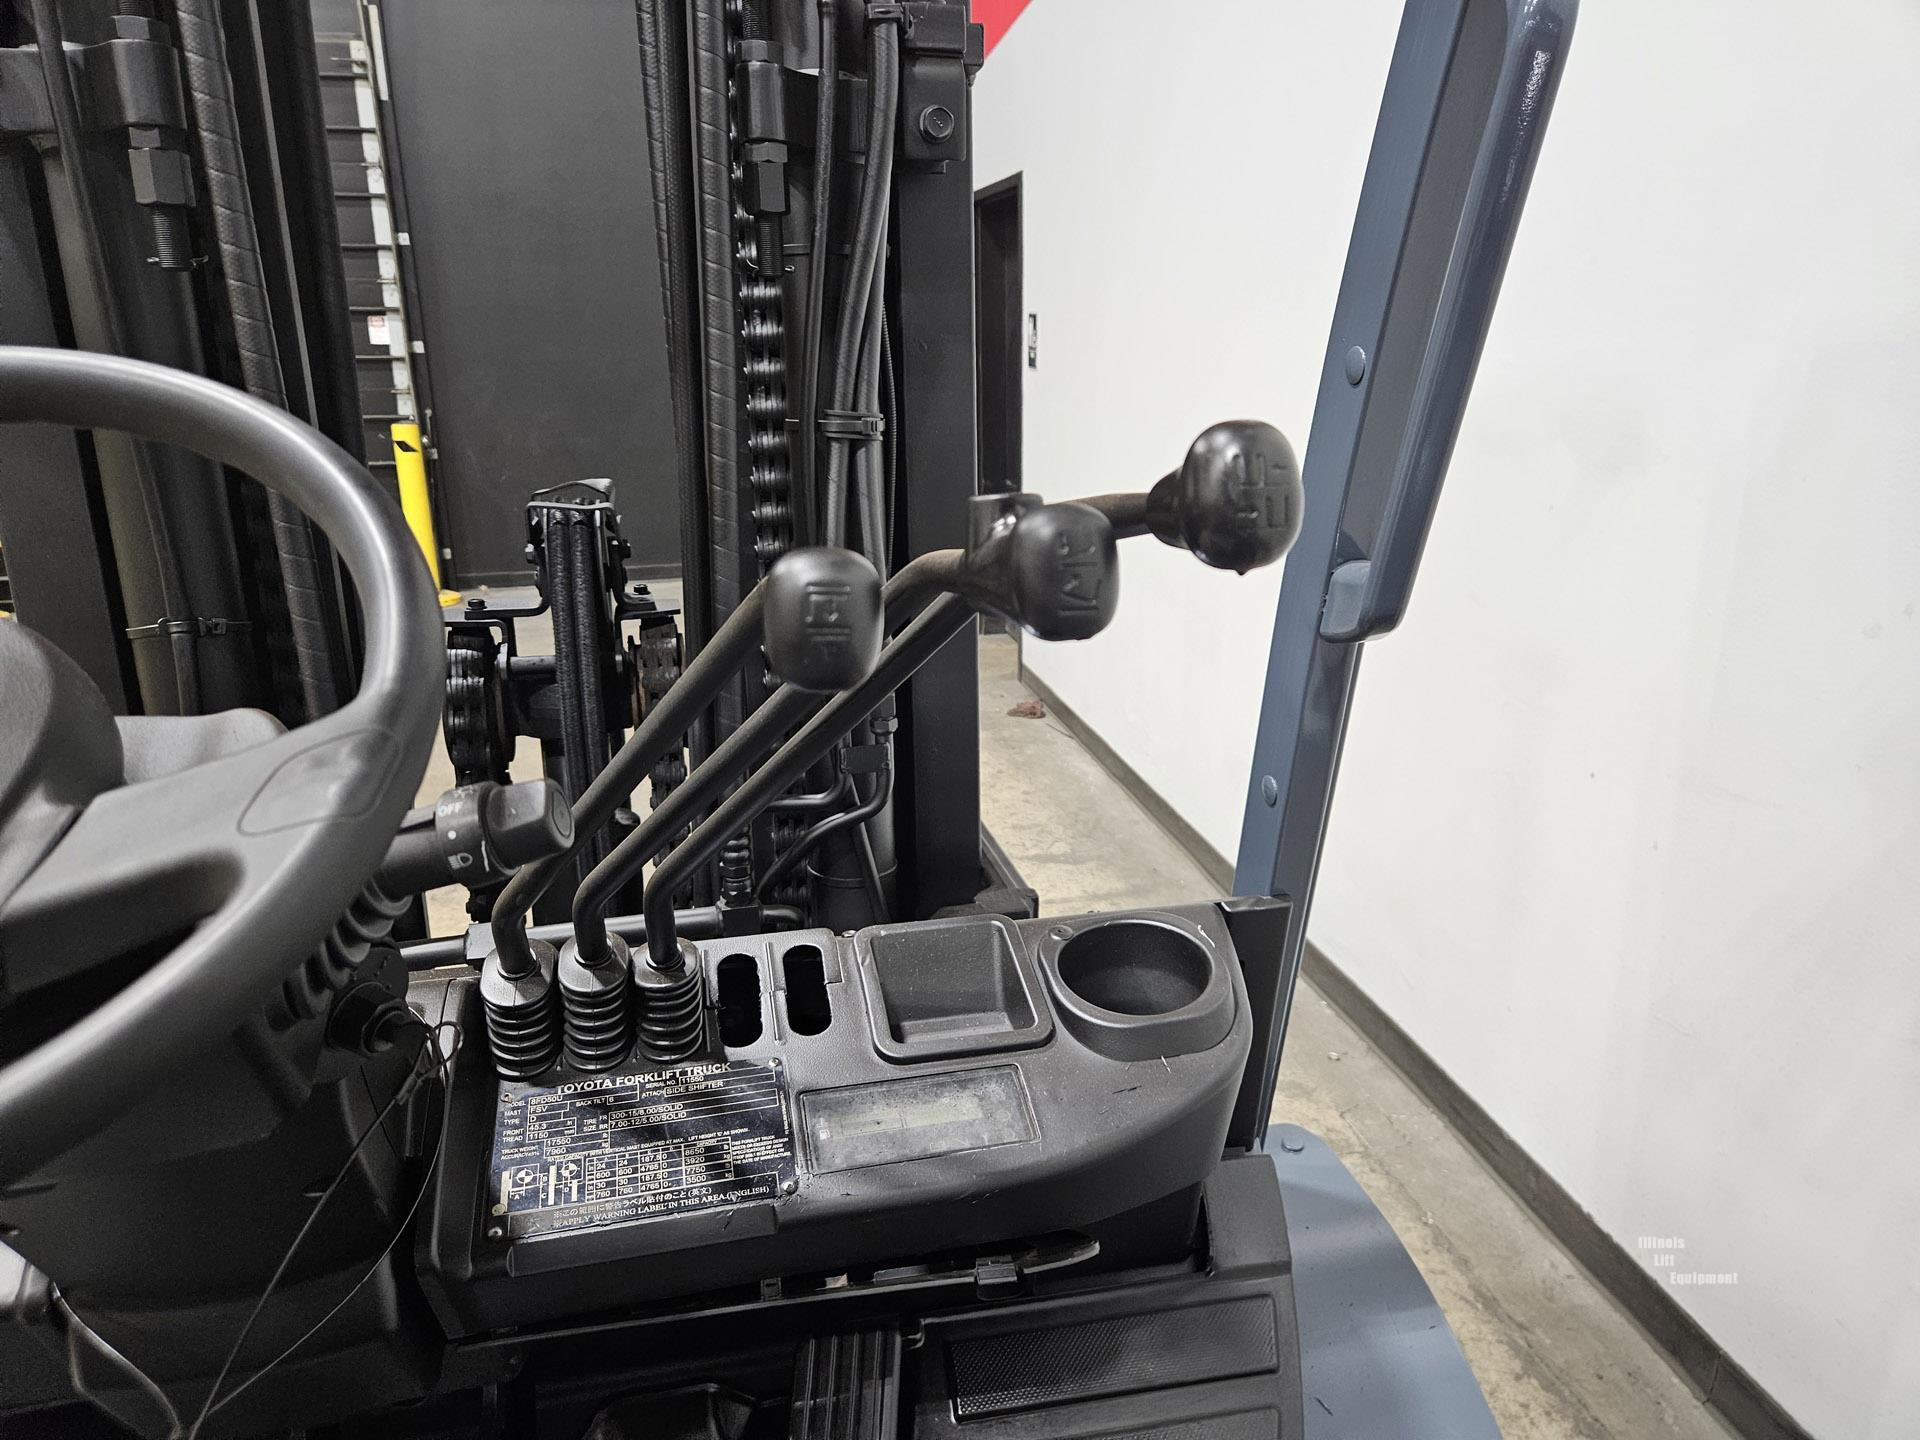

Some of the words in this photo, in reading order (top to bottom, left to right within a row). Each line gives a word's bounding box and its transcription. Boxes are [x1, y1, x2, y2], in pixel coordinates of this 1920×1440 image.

[438, 801, 463, 817] OFF
[558, 1079, 613, 1095] TOYOTA
[616, 1069, 682, 1086] FORKLIFT
[685, 1062, 731, 1077] TRUCK
[645, 1081, 666, 1089] SERIAL
[681, 1075, 704, 1084] 11550
[666, 1086, 687, 1095] SIDE
[688, 1082, 724, 1092] SHIFTER
[505, 1109, 522, 1117] MAST
[530, 1105, 548, 1114] FSV
[504, 1118, 520, 1126] TYPE
[529, 1123, 547, 1131] 45.3
[503, 1128, 524, 1137] FRONT
[529, 1132, 549, 1140] 1150
[503, 1136, 523, 1144] TREAD
[546, 1138, 571, 1146] 17550
[741, 1137, 761, 1145] FORKLIFT
[519, 1145, 539, 1153] WEIGHT
[546, 1147, 566, 1156] 7960
[685, 1147, 705, 1156] 8650
[618, 1168, 633, 1176] 600
[641, 1165, 659, 1173] 4765
[685, 1157, 705, 1165] 3920
[686, 1166, 706, 1175] 7750
[596, 1190, 611, 1198] 760
[619, 1187, 633, 1195] 760
[641, 1183, 660, 1192] 4765
[686, 1175, 707, 1184] 3500
[593, 1205, 636, 1221] WARNING
[638, 1202, 665, 1214] LABEL
[668, 1201, 678, 1209] IN
[680, 1197, 699, 1207] THIS
